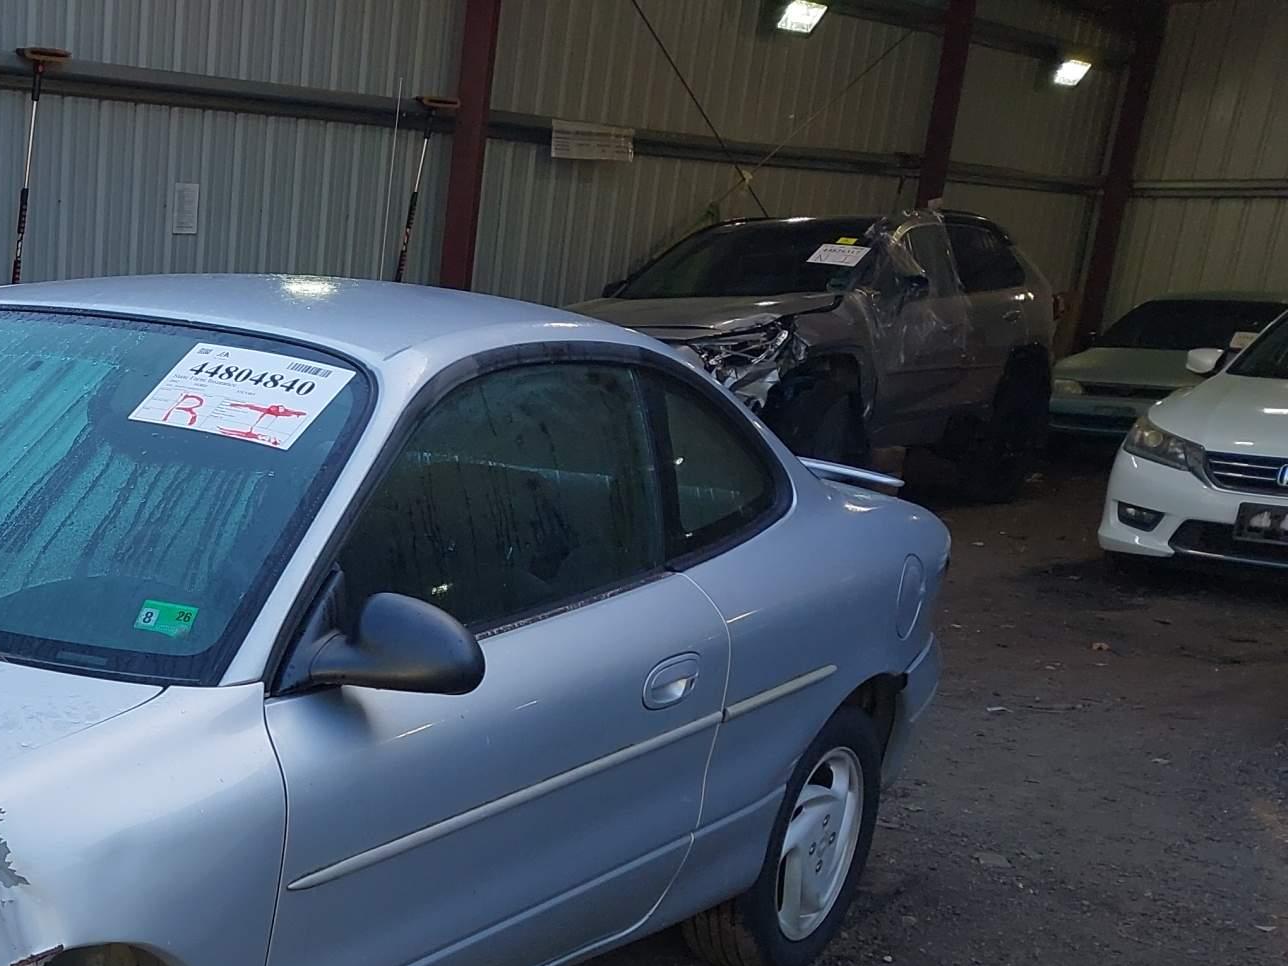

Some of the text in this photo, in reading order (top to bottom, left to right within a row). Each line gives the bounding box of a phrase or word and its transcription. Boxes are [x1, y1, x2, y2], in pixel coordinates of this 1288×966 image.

[189, 361, 316, 396] 44804840
[142, 610, 193, 624] 8 26
